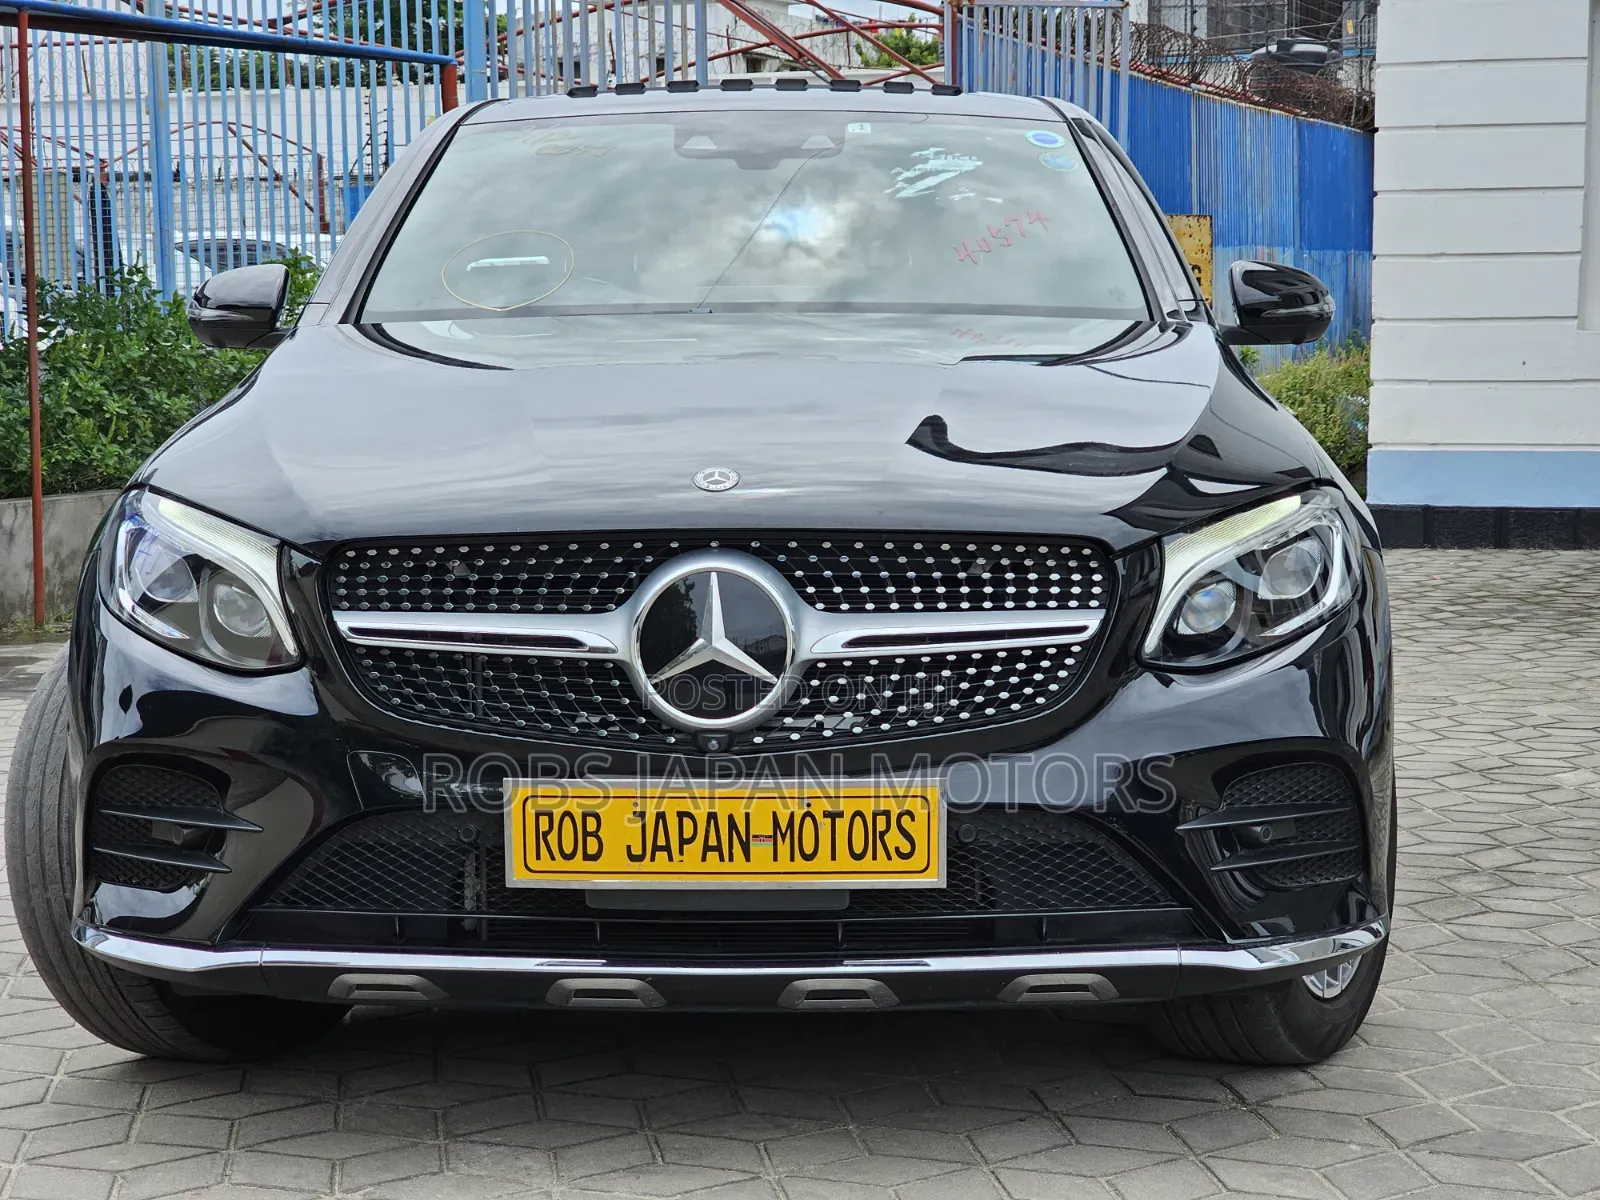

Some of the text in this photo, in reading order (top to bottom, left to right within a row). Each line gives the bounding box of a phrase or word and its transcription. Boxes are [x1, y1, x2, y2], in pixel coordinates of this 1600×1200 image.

[952, 209, 1052, 265] 40574
[534, 809, 917, 864] ROB JAPAN MOTORS
